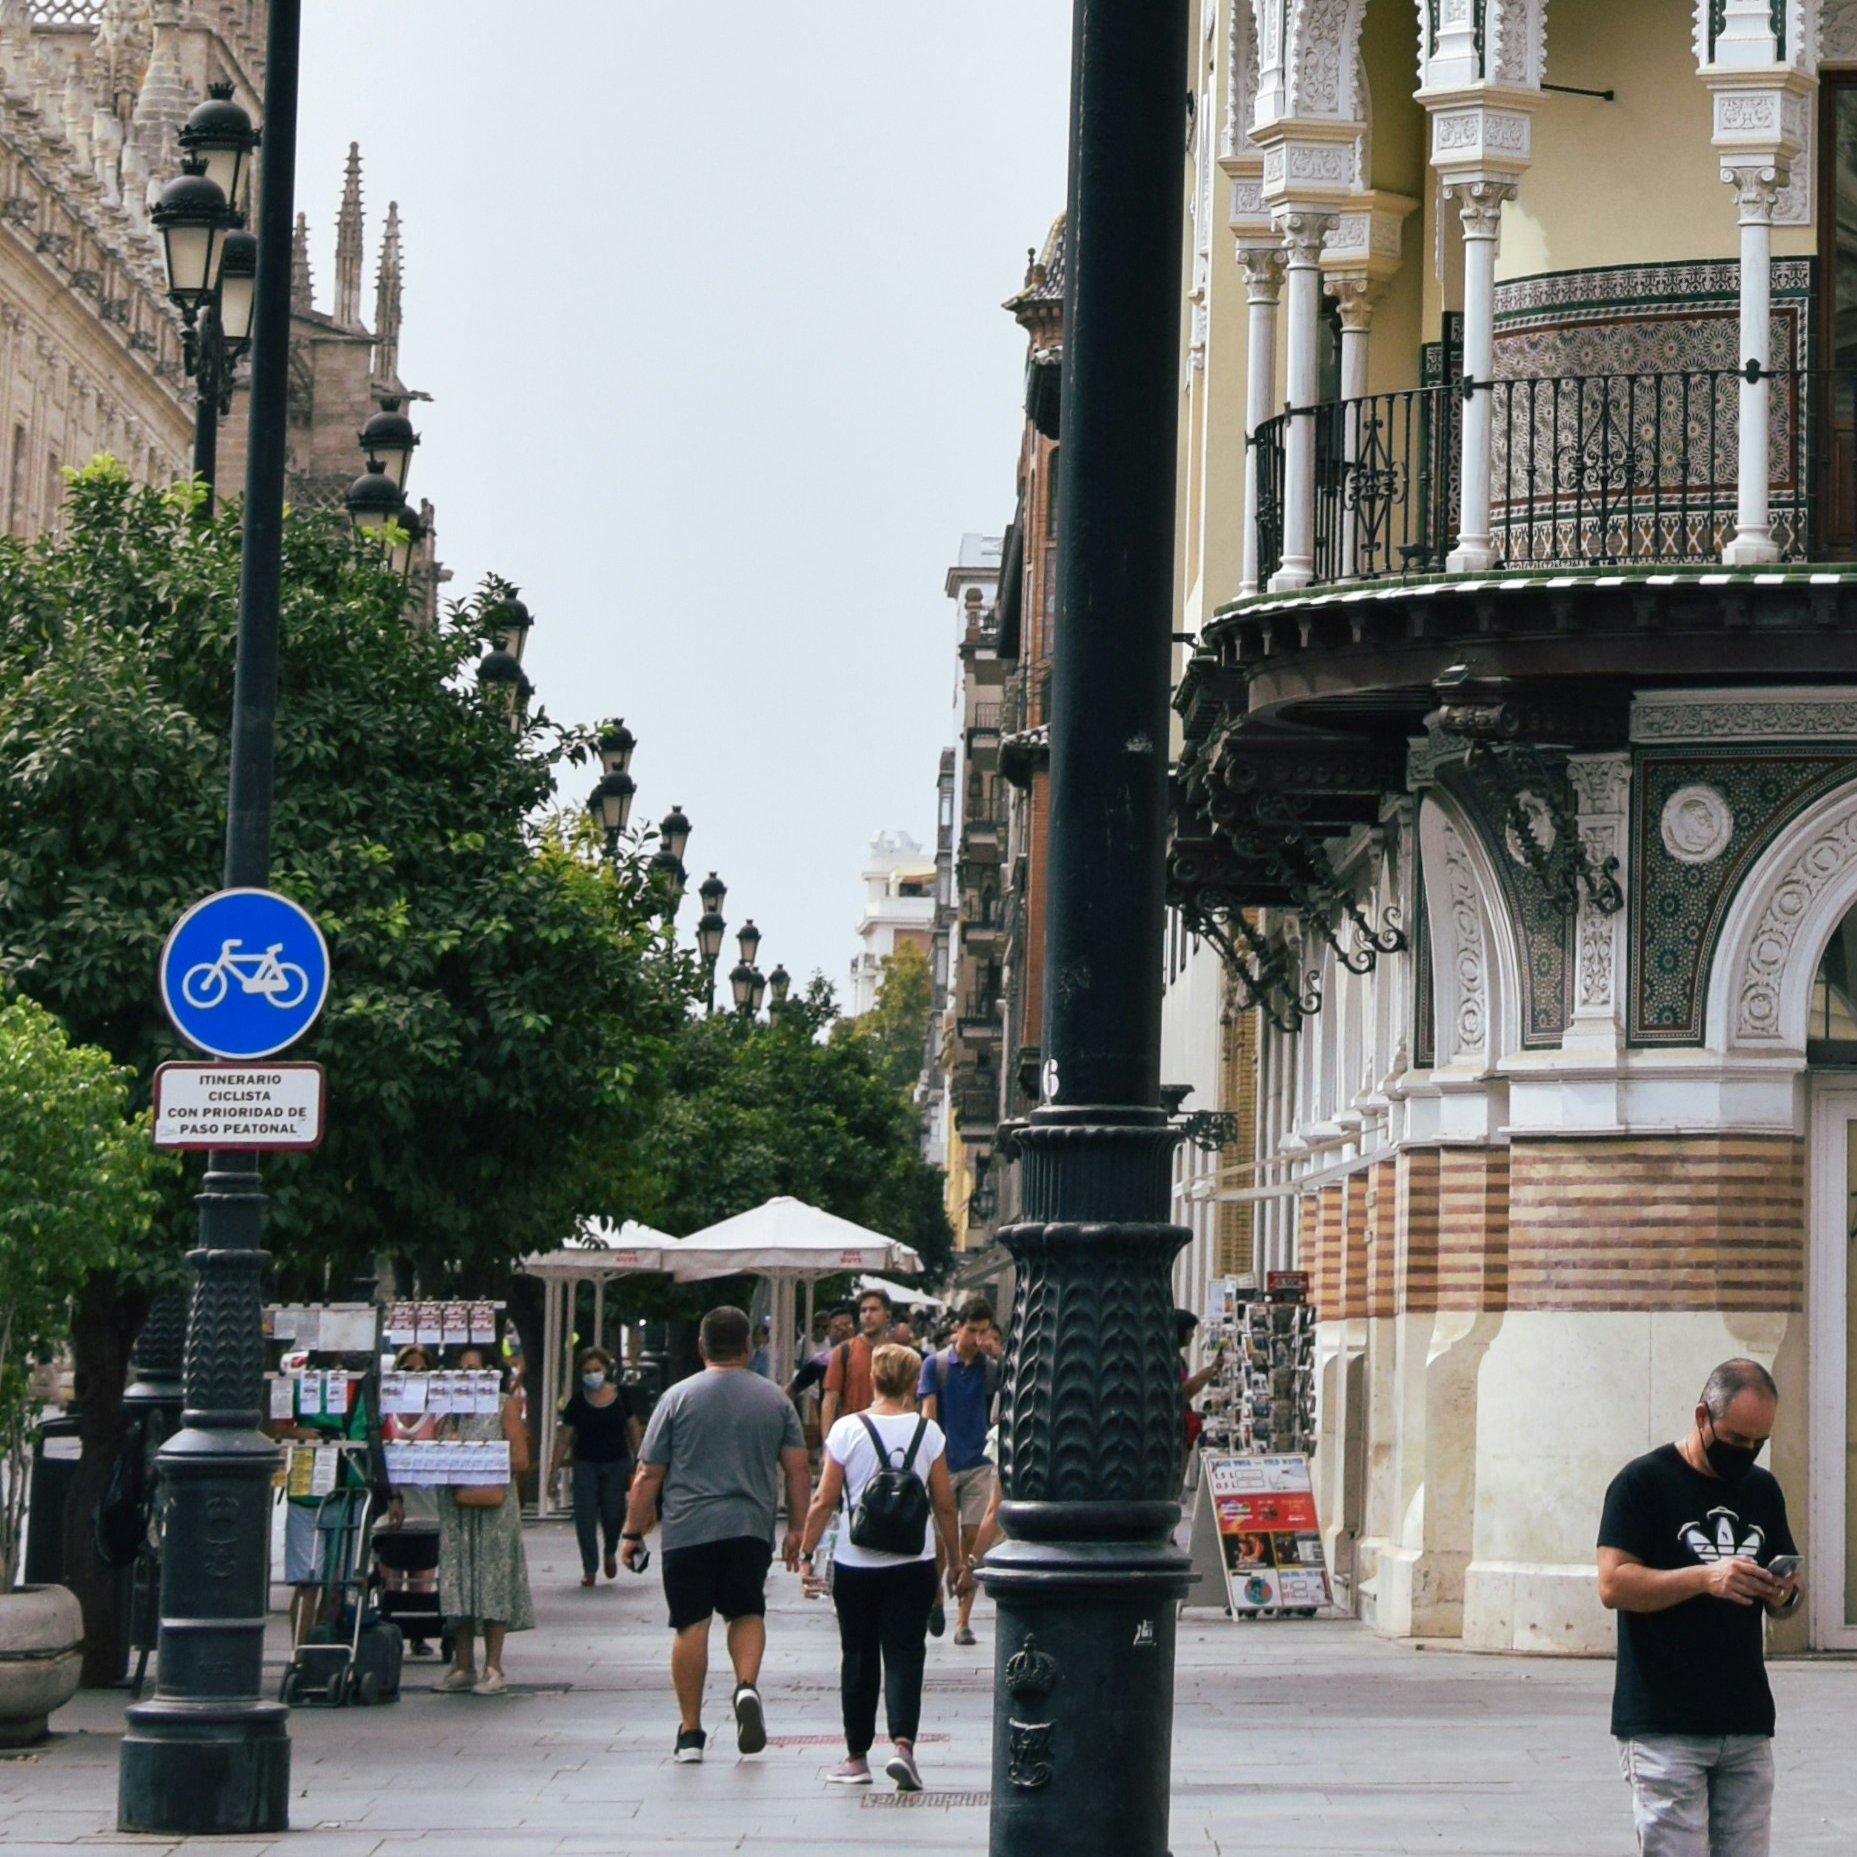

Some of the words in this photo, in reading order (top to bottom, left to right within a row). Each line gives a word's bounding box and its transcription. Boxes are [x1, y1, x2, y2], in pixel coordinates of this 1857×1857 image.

[200, 1074, 282, 1085] ITINERARIO
[208, 1091, 271, 1101] CICLISTA
[167, 1107, 198, 1118] CON
[202, 1107, 284, 1117] PRIORIDAD
[287, 1107, 307, 1117] DE
[180, 1124, 219, 1134] PASO
[223, 1123, 297, 1134] PEATONAL
